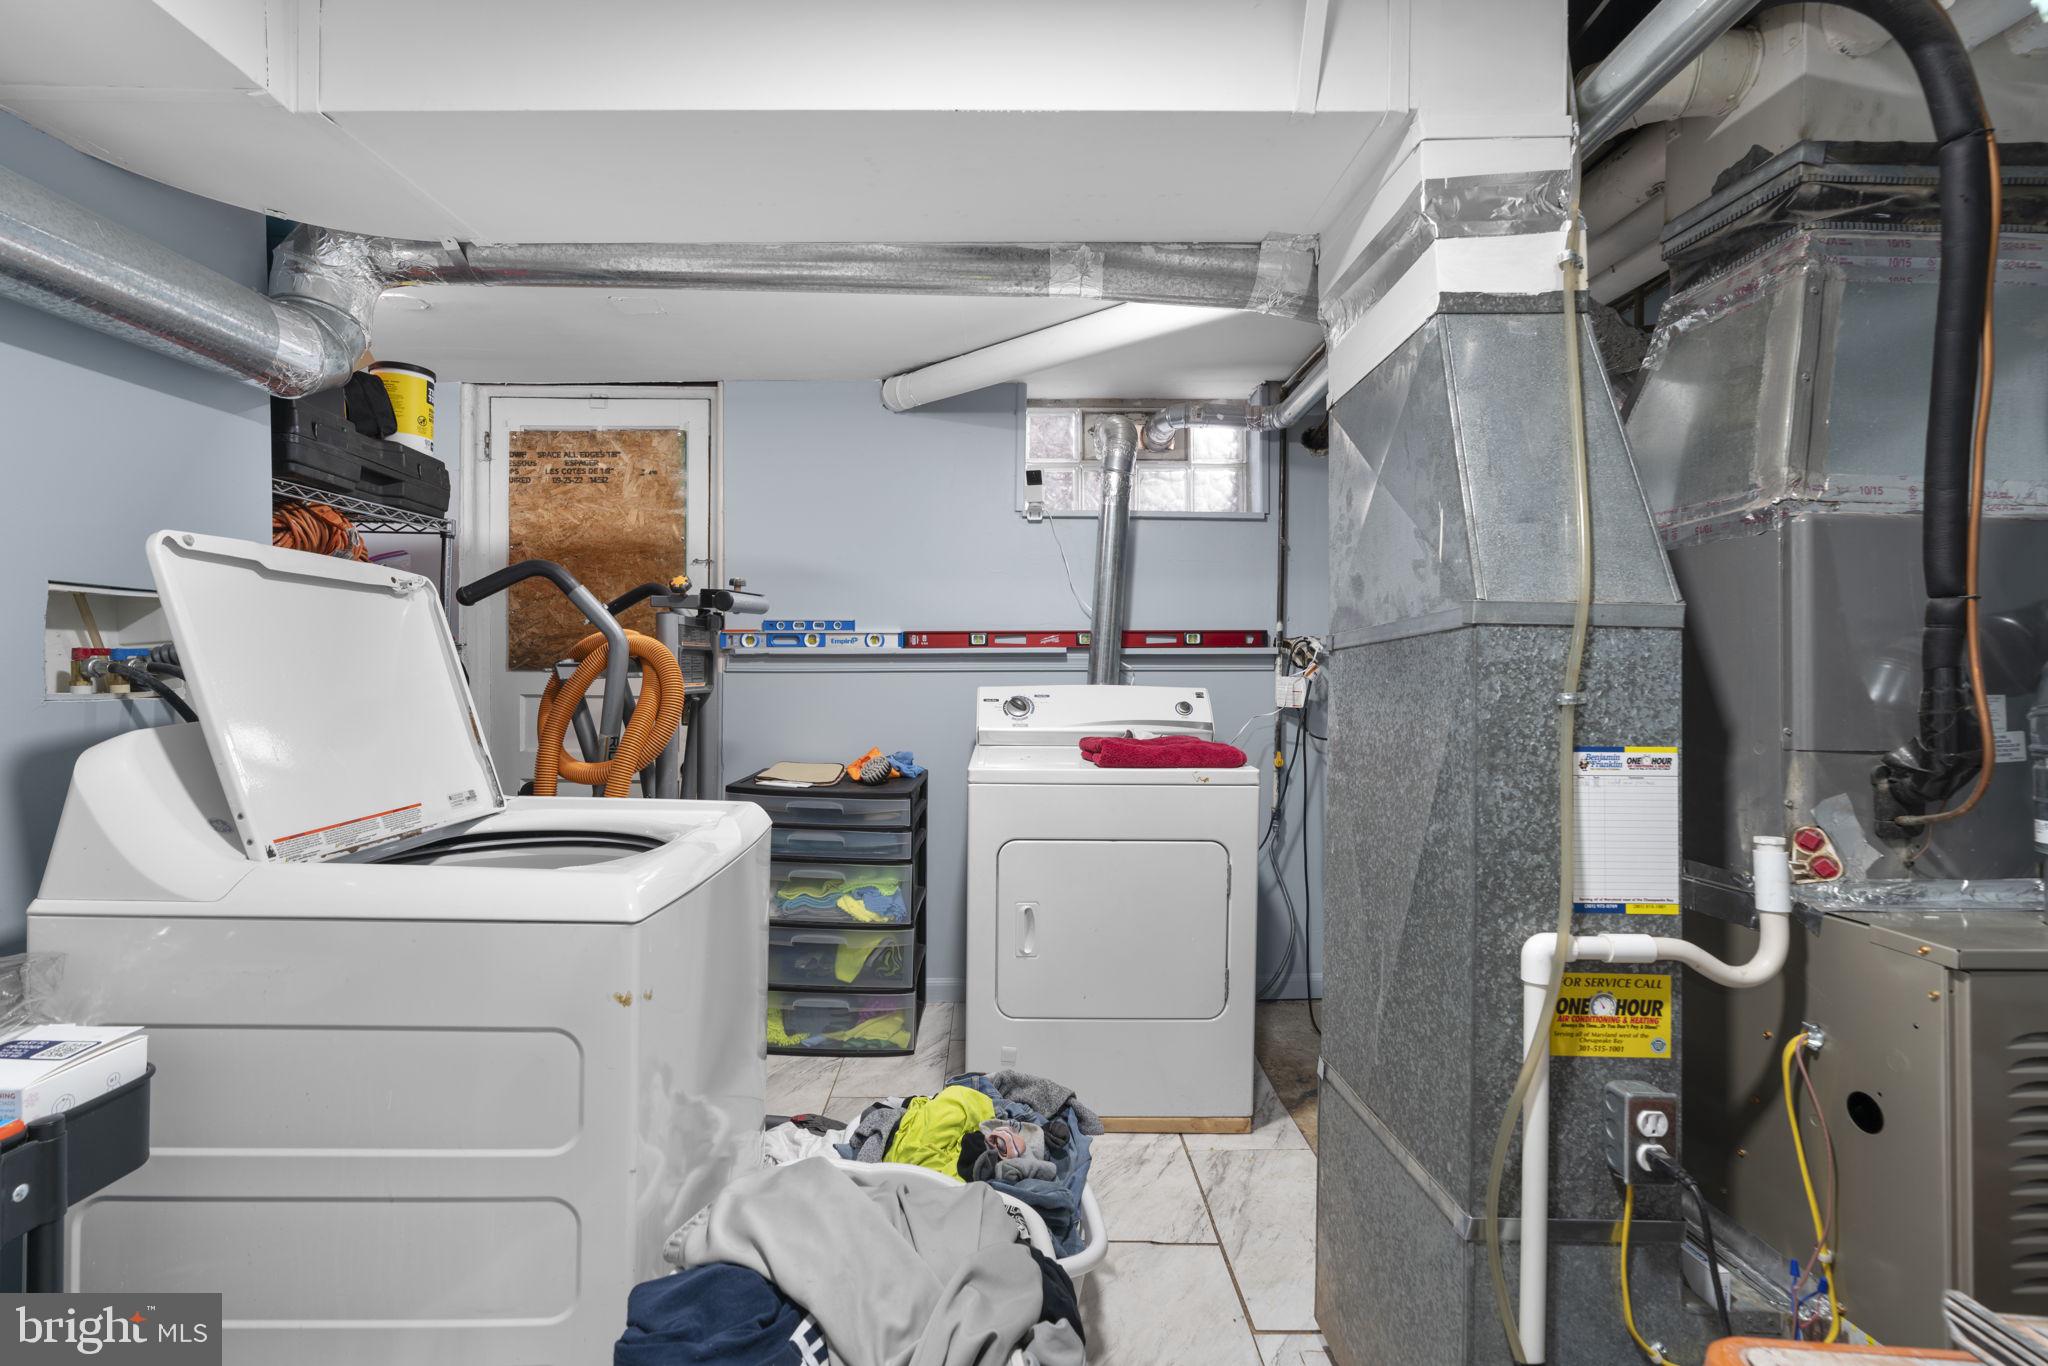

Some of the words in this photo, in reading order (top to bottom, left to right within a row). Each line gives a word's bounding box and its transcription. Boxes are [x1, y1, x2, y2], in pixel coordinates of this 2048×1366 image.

[537, 451, 561, 459] SPACE
[563, 451, 577, 459] ALL
[1859, 485, 1884, 496] 10/15
[1585, 754, 1620, 762] Benjamin
[1626, 757, 1642, 765] ONE
[1651, 757, 1672, 765] HOUR
[1590, 760, 1623, 768] Franklin
[1562, 977, 1580, 987] OR
[1584, 977, 1632, 989] SERVICE
[1634, 978, 1663, 989] CALL
[1556, 997, 1590, 1015] ONE
[1615, 999, 1664, 1016] HOUR
[1571, 1015, 1620, 1024] CONDITIONING
[1578, 1045, 1624, 1053] 301-515-1001
